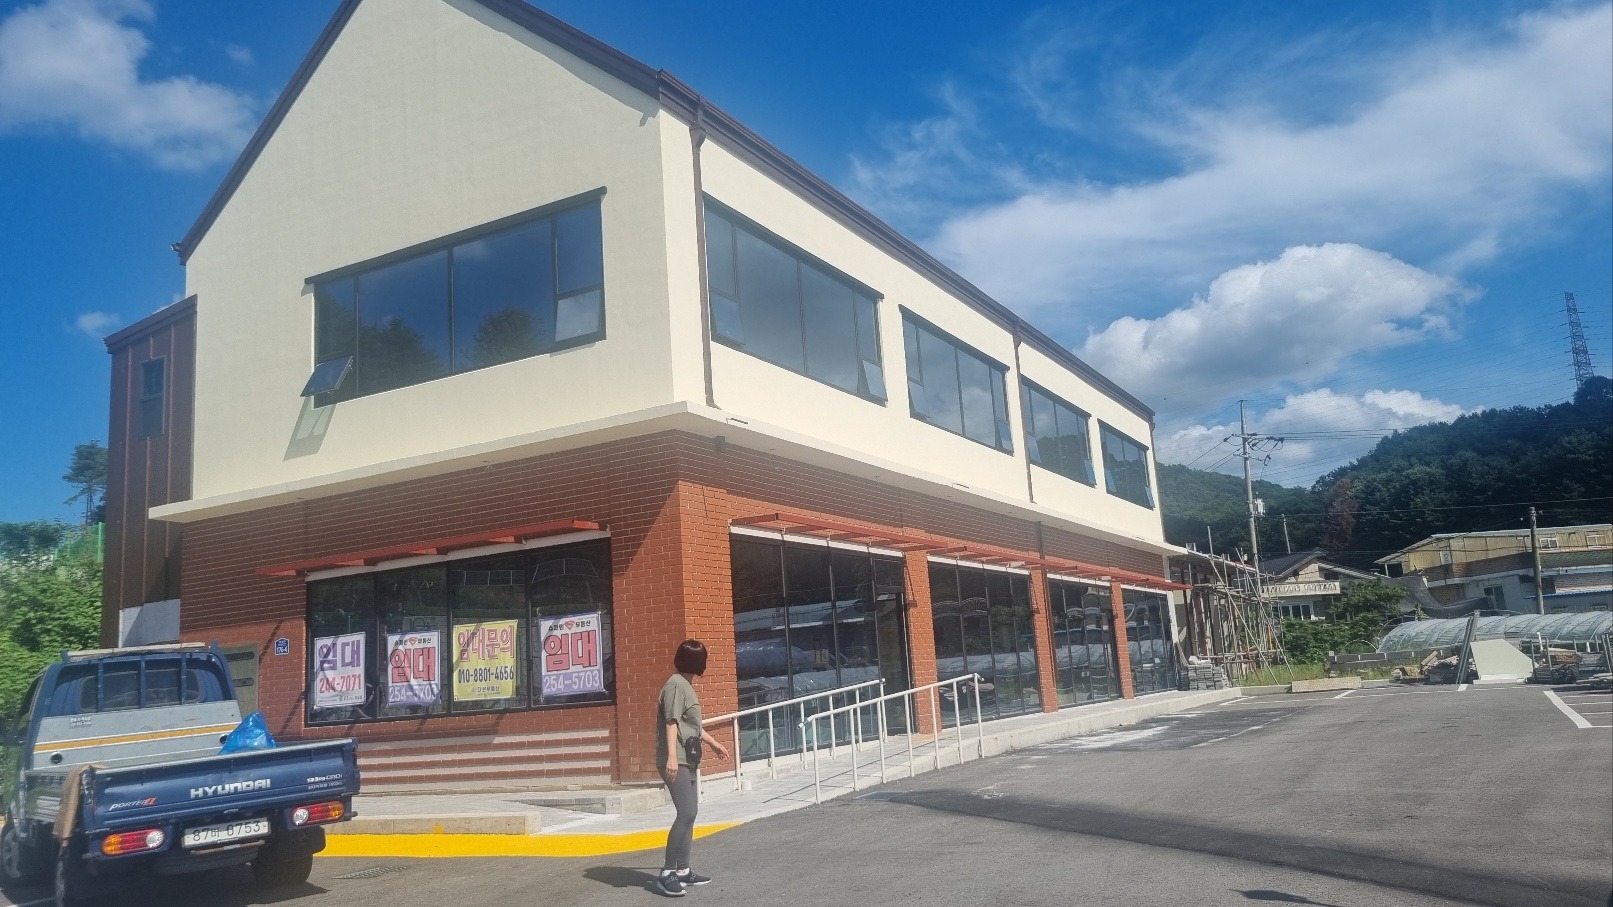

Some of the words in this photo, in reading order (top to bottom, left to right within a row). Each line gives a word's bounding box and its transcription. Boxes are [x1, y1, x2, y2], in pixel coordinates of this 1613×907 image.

[318, 640, 361, 671] 임대
[458, 625, 514, 662] 임대문의
[544, 629, 598, 672] 임대
[390, 647, 436, 683] 임대
[458, 665, 514, 684] 010-8801-4656
[544, 670, 600, 693] 254-5703
[190, 778, 271, 799] HYUNDAI
